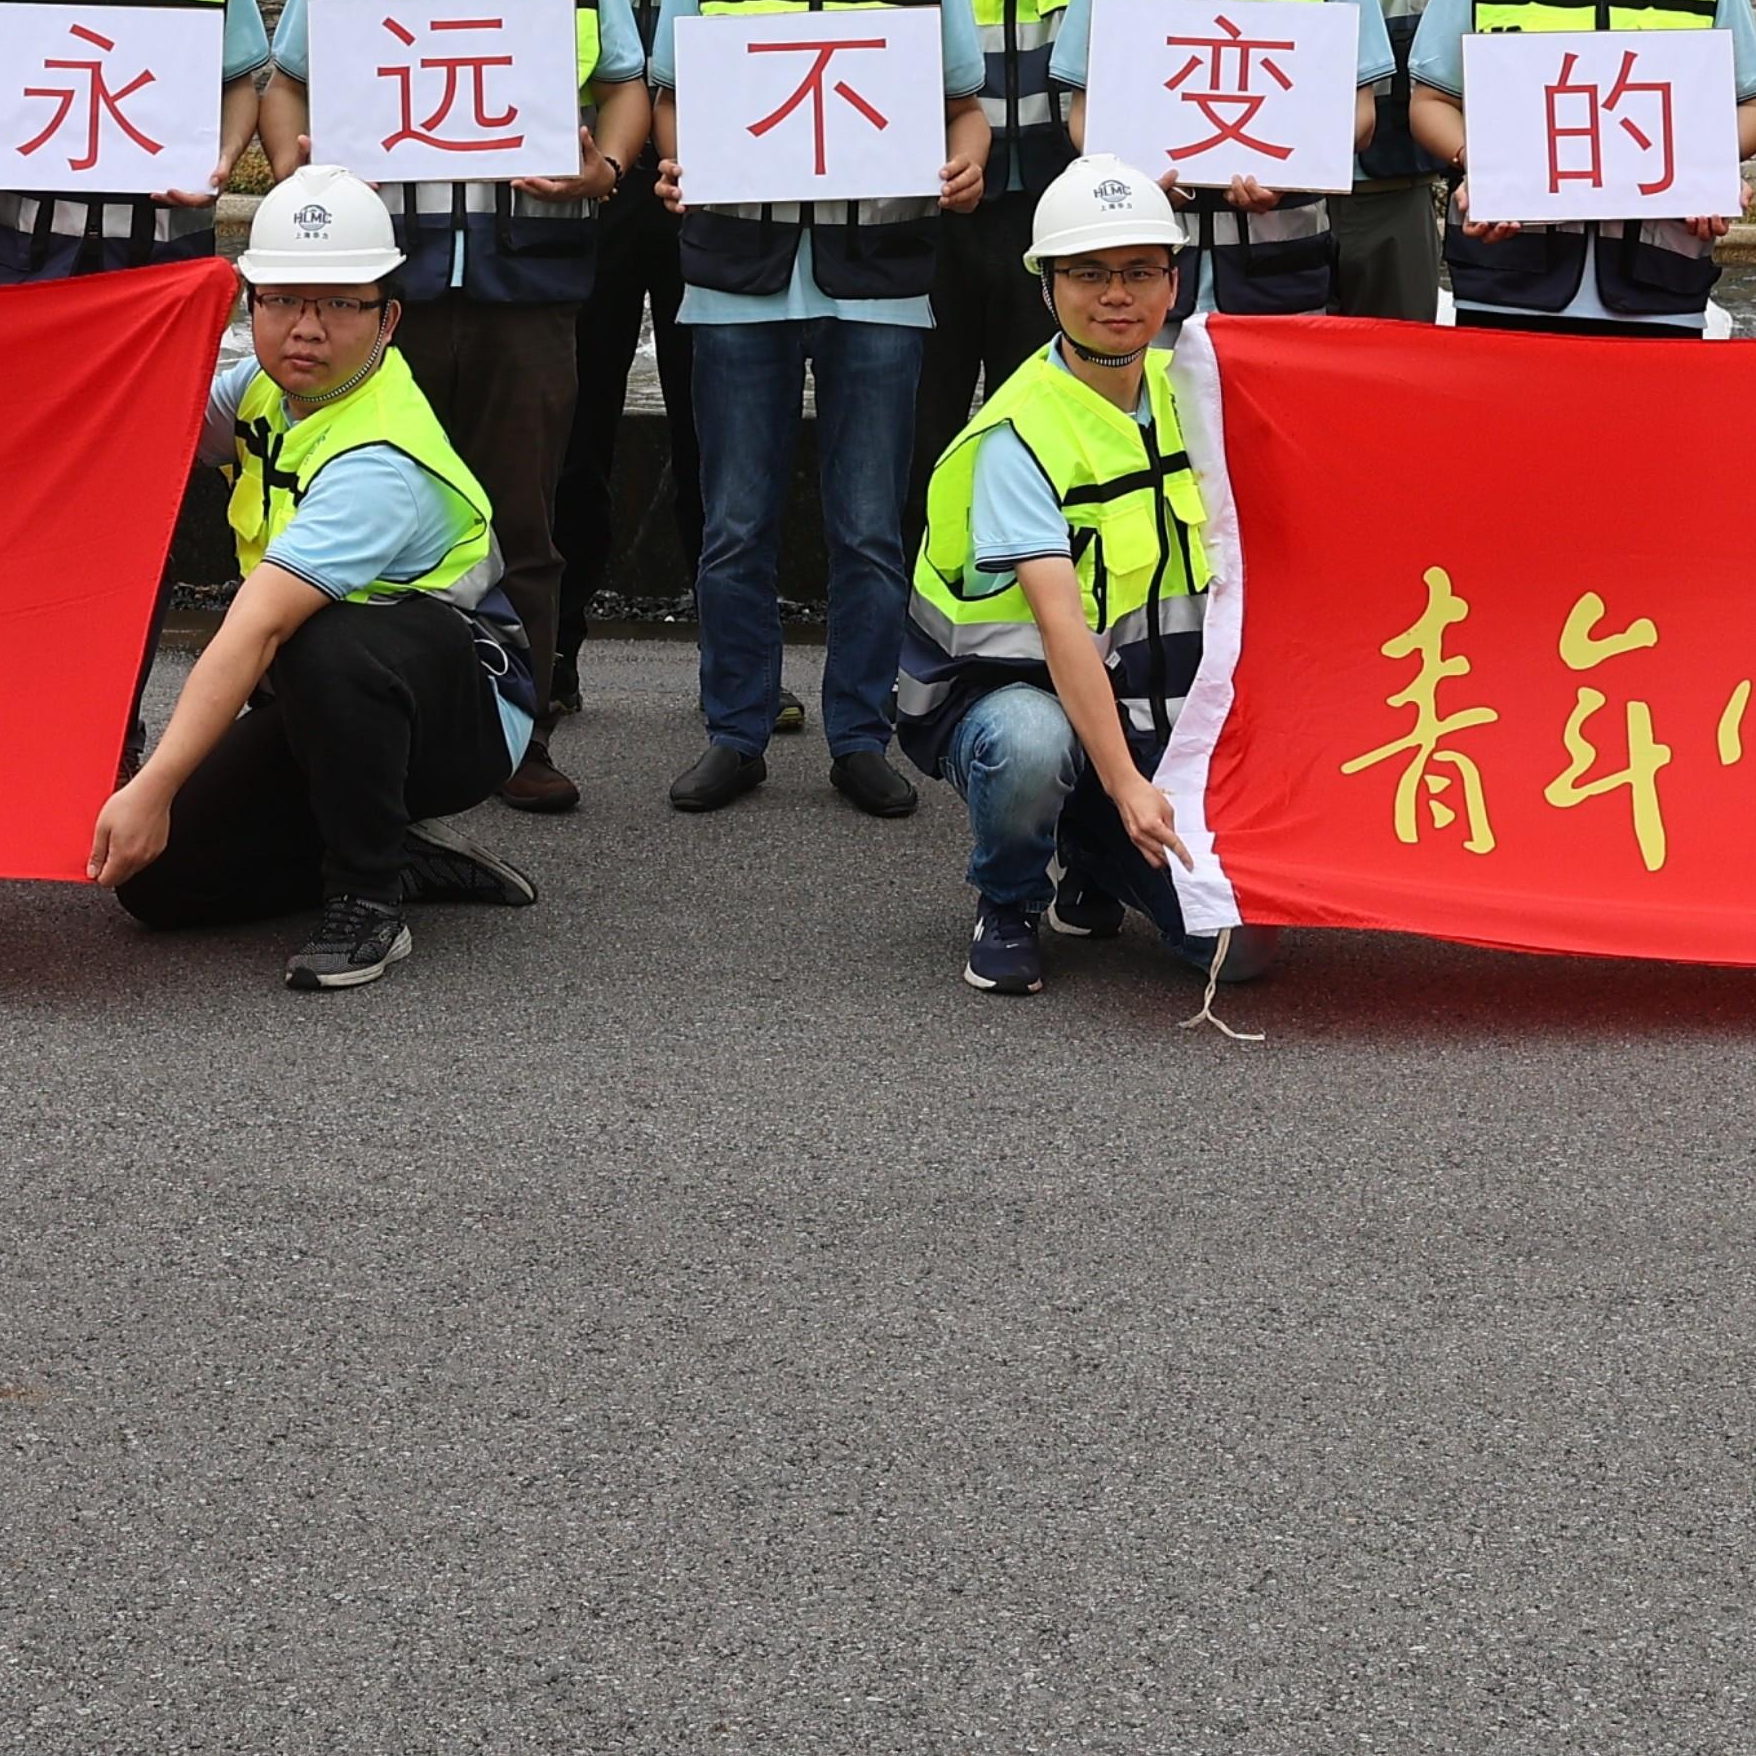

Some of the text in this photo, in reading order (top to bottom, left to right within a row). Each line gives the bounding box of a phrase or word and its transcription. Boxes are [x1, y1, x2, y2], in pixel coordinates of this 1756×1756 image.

[21, 26, 160, 169] 永
[380, 20, 521, 151] 远
[750, 40, 885, 173] 不
[1168, 18, 1293, 159] 变
[1547, 52, 1673, 195] 的
[294, 213, 332, 224] HLMC
[1094, 186, 1132, 198] HLMC
